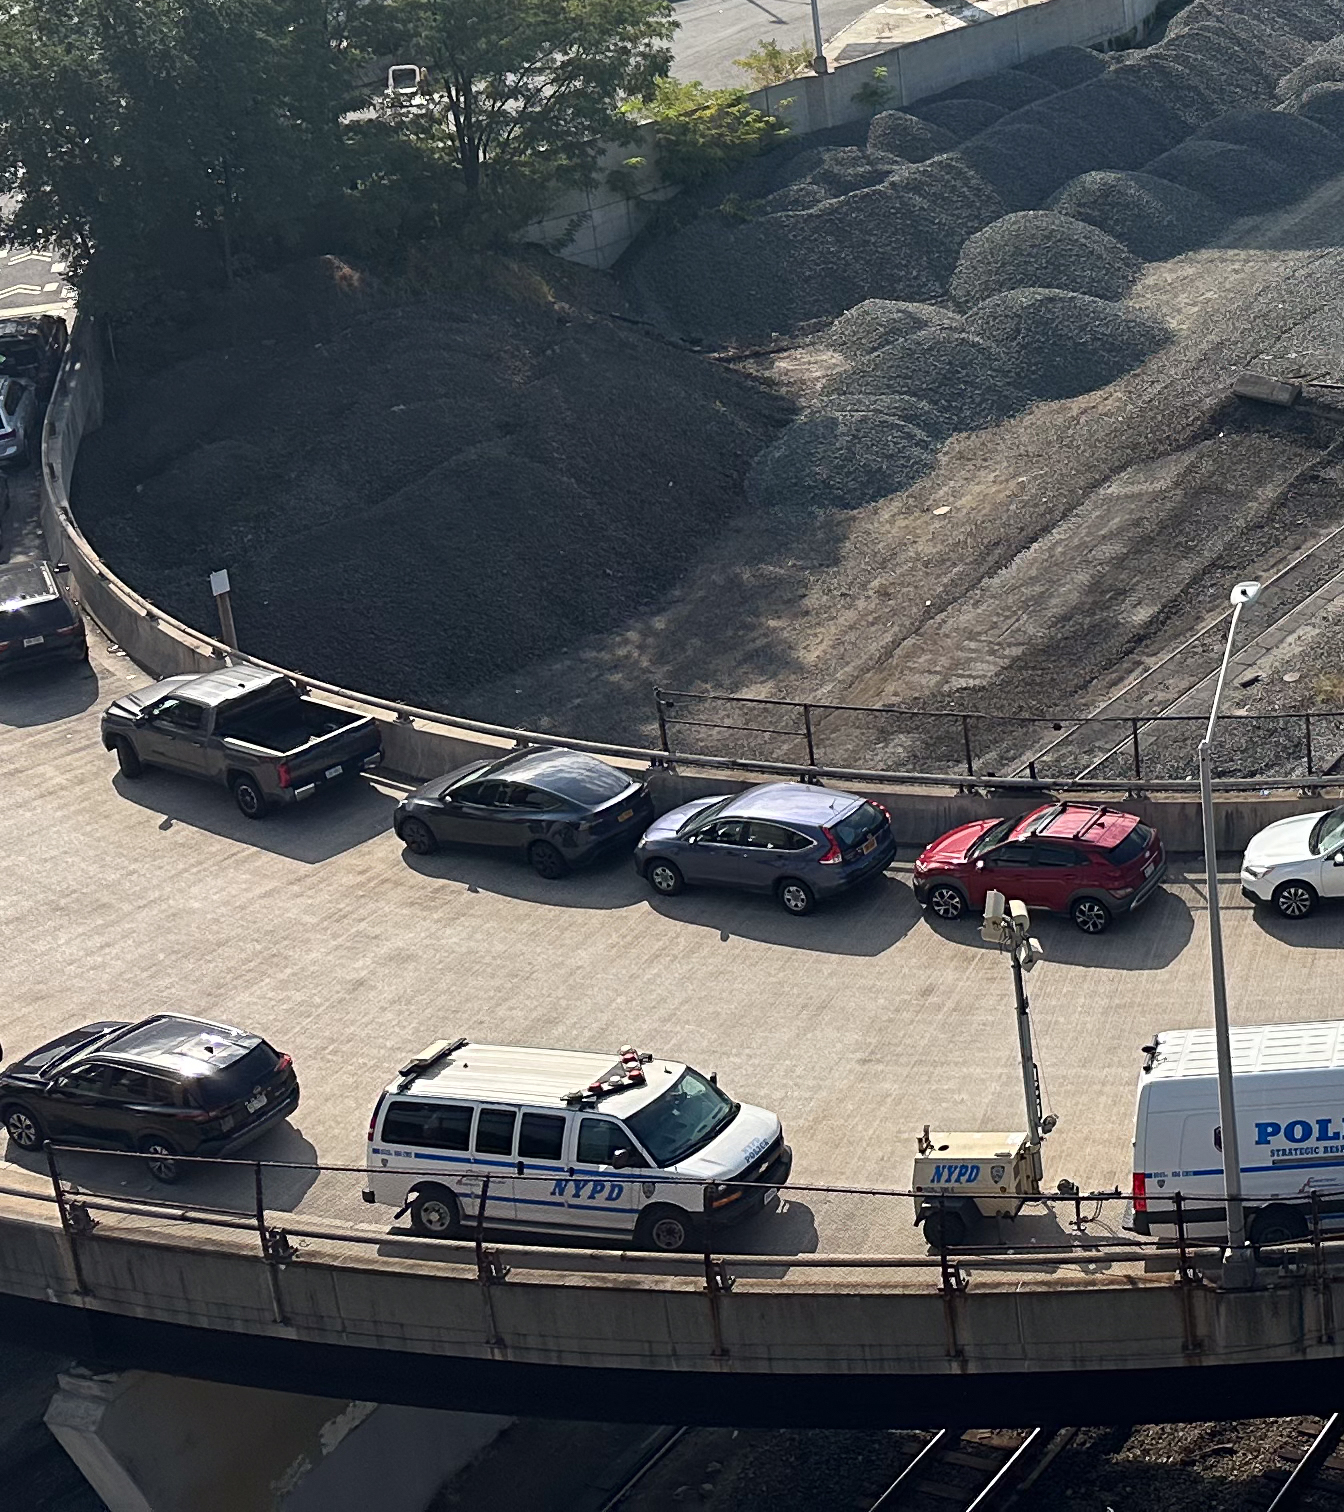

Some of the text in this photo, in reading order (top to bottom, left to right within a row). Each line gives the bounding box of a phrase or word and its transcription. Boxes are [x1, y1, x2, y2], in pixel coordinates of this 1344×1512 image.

[1270, 1146, 1320, 1158] STRATEGIC
[930, 1163, 981, 1184] NYPD
[550, 1179, 625, 1202] NYPD
